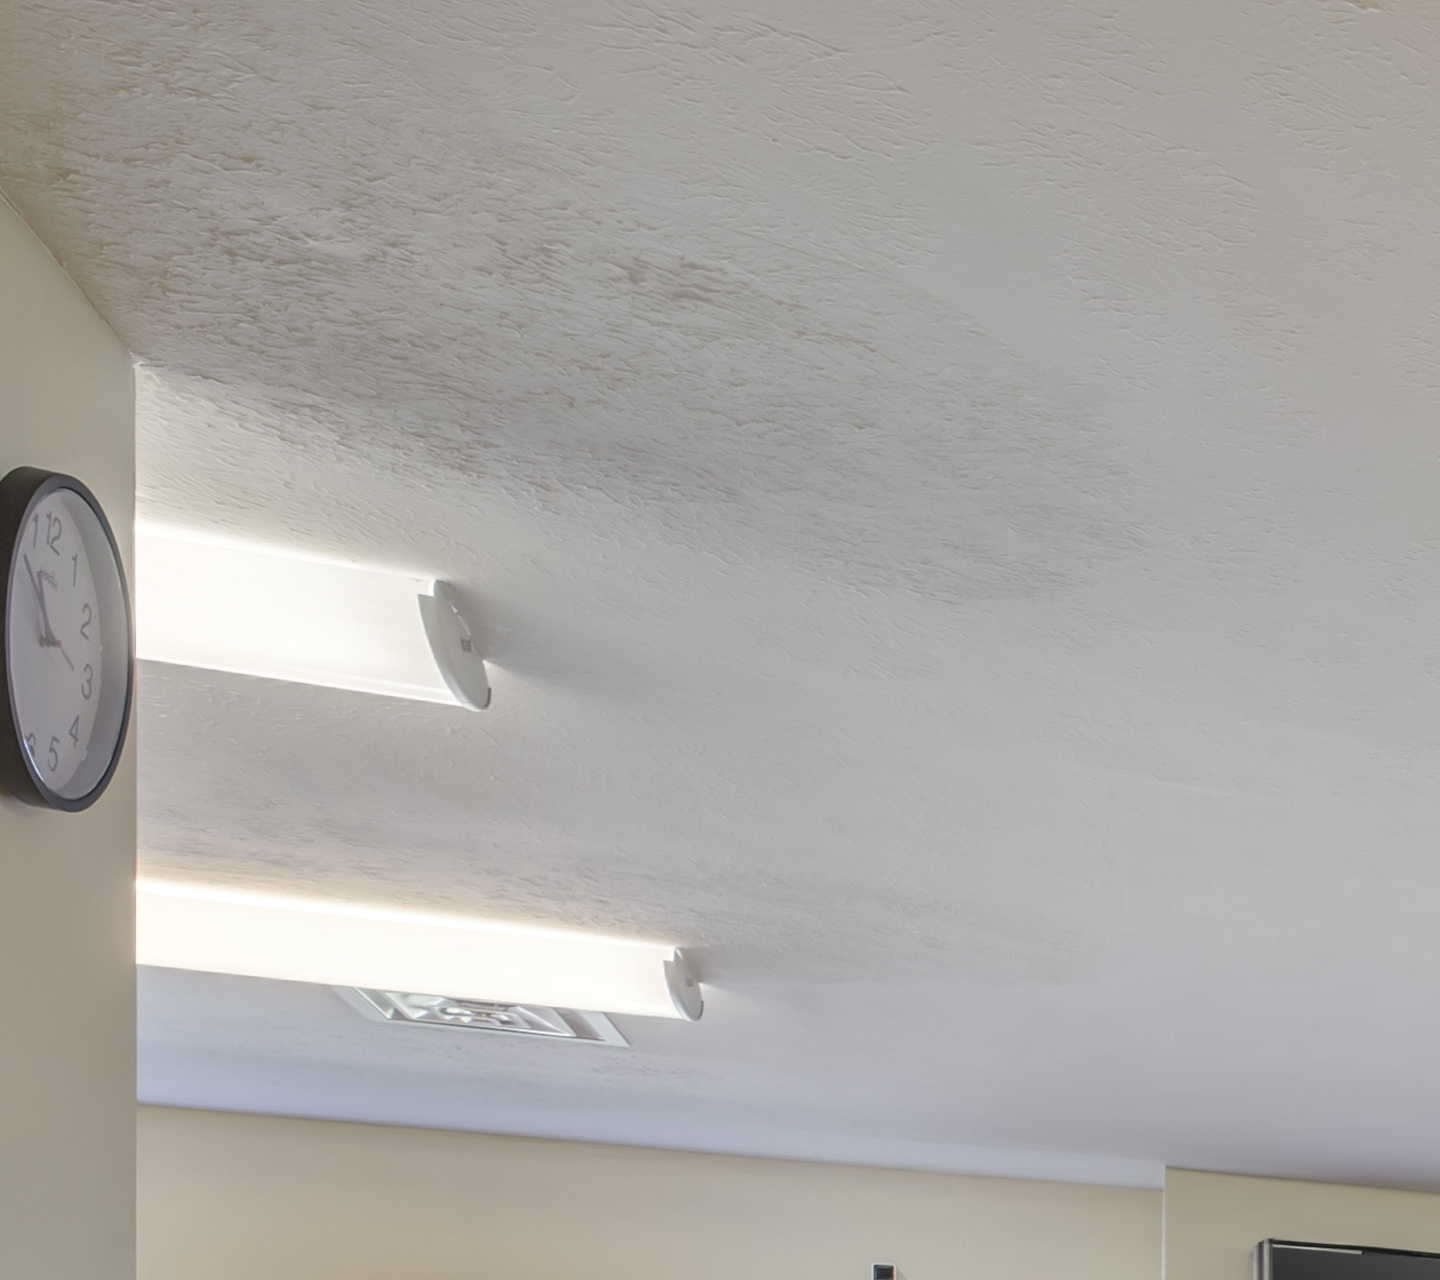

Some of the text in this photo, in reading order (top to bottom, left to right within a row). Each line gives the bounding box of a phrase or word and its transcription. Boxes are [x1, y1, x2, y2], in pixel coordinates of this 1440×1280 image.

[45, 511, 62, 556] 12
[71, 553, 78, 588] 1
[80, 603, 93, 640] 2
[81, 663, 93, 700] 3
[68, 714, 79, 749] 4
[47, 735, 60, 772] 5
